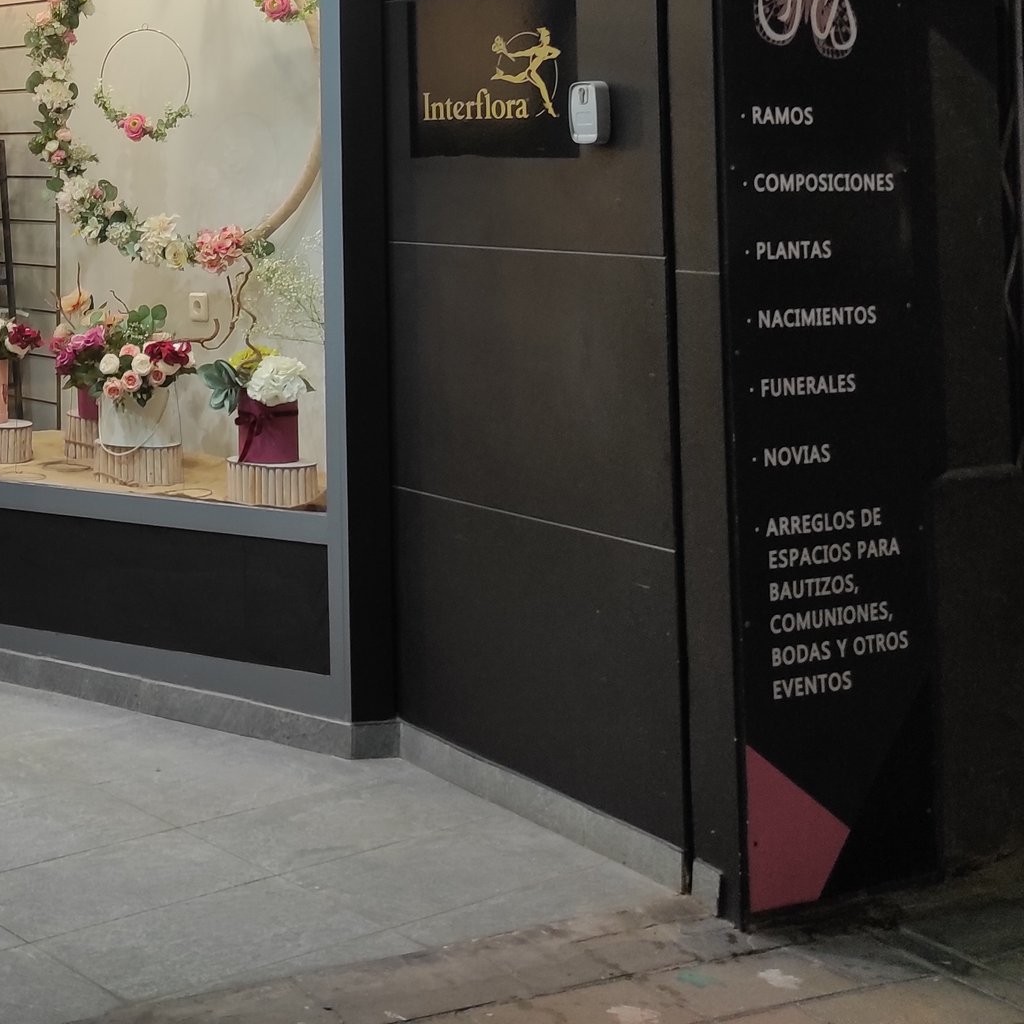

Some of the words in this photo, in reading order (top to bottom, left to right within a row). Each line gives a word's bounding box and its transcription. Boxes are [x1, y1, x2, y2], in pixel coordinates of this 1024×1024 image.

[423, 88, 529, 121] Interflora
[751, 105, 814, 126] RAMOS
[753, 172, 895, 193] COMPOSICIONES
[756, 239, 832, 260] PLANTAS
[758, 305, 877, 329] NACIMIENTOS
[760, 373, 856, 398] FUNERALES
[764, 443, 831, 467] NOVIAS
[765, 510, 855, 538] ARREGLOS
[860, 507, 882, 527] DE
[768, 542, 852, 569] ESPACIOS
[857, 537, 901, 560] PARA
[769, 573, 859, 602] BAUTIZOS,
[769, 600, 893, 634] COMUNIONES,
[771, 640, 832, 667] BODAS
[836, 638, 848, 658] Y
[853, 630, 909, 656] OTROS
[772, 670, 852, 700] EVENTOS
